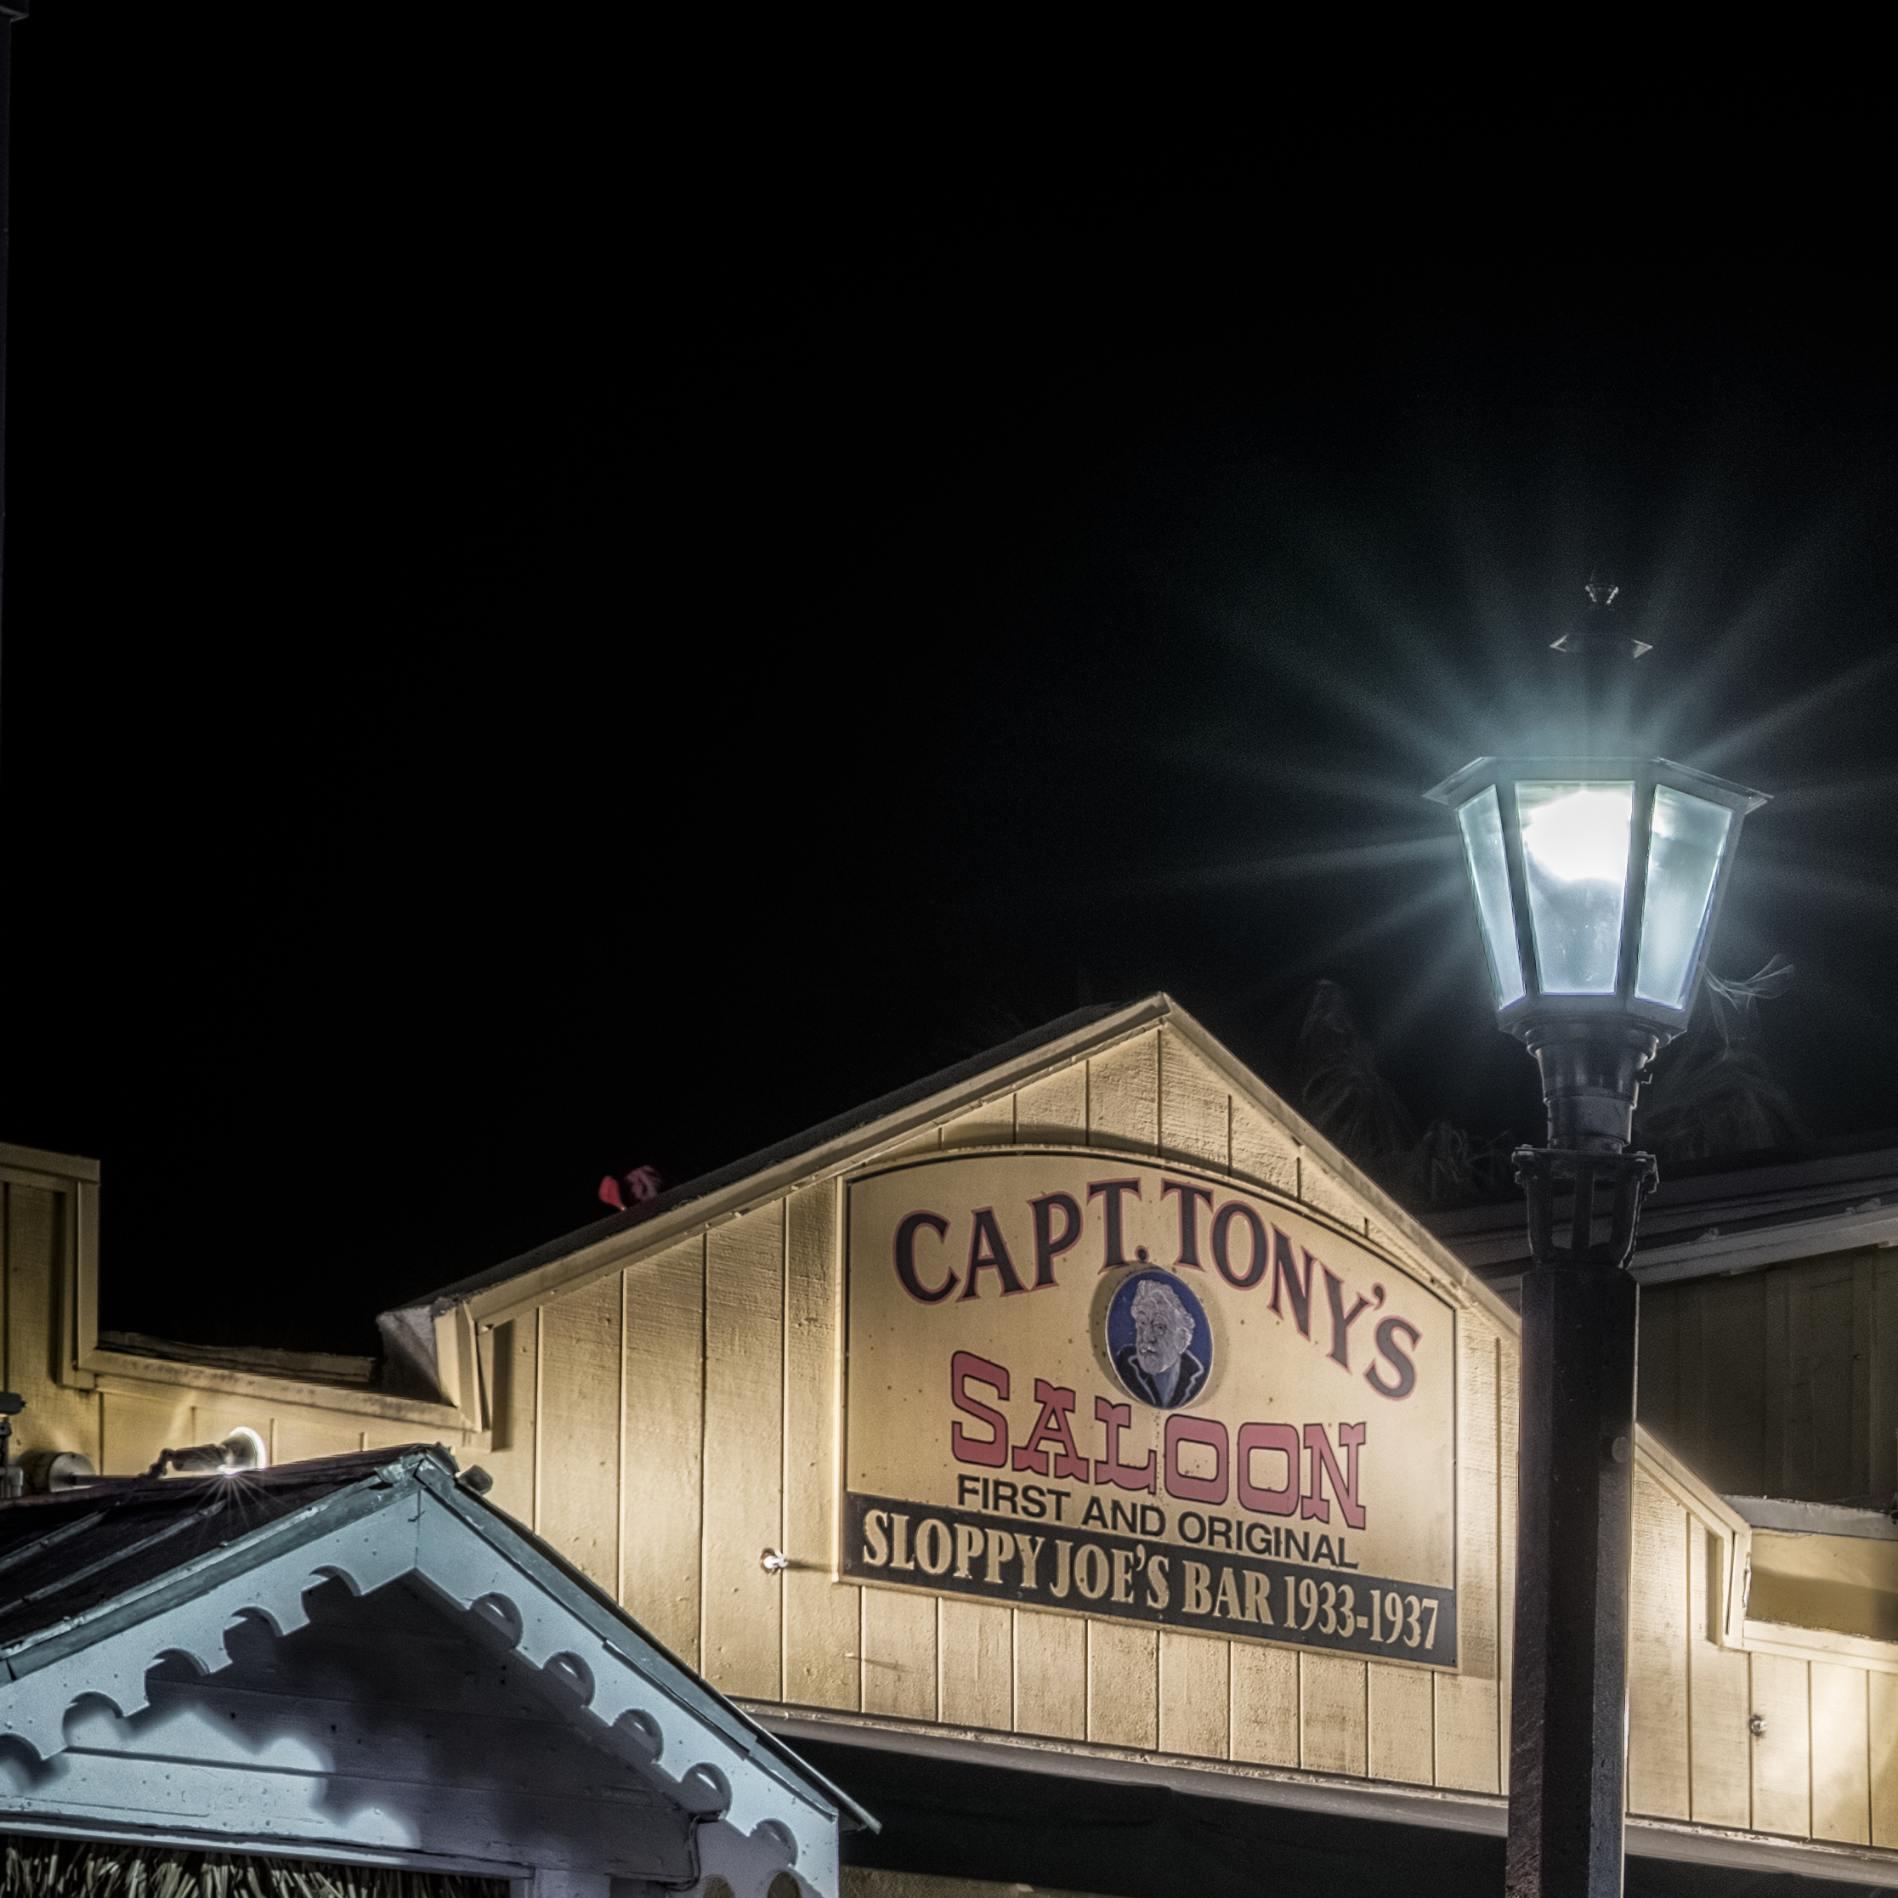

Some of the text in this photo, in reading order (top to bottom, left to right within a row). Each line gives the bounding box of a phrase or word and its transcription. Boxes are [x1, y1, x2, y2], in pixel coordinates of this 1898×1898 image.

[893, 1177, 1423, 1402] CAPT. TONY'S
[949, 1350, 1367, 1530] SALOON
[861, 1508, 1441, 1652] SLOPPY JOE'S BAR 1933-1937
[956, 1473, 1360, 1570] FIRST AND ORIGINAL
